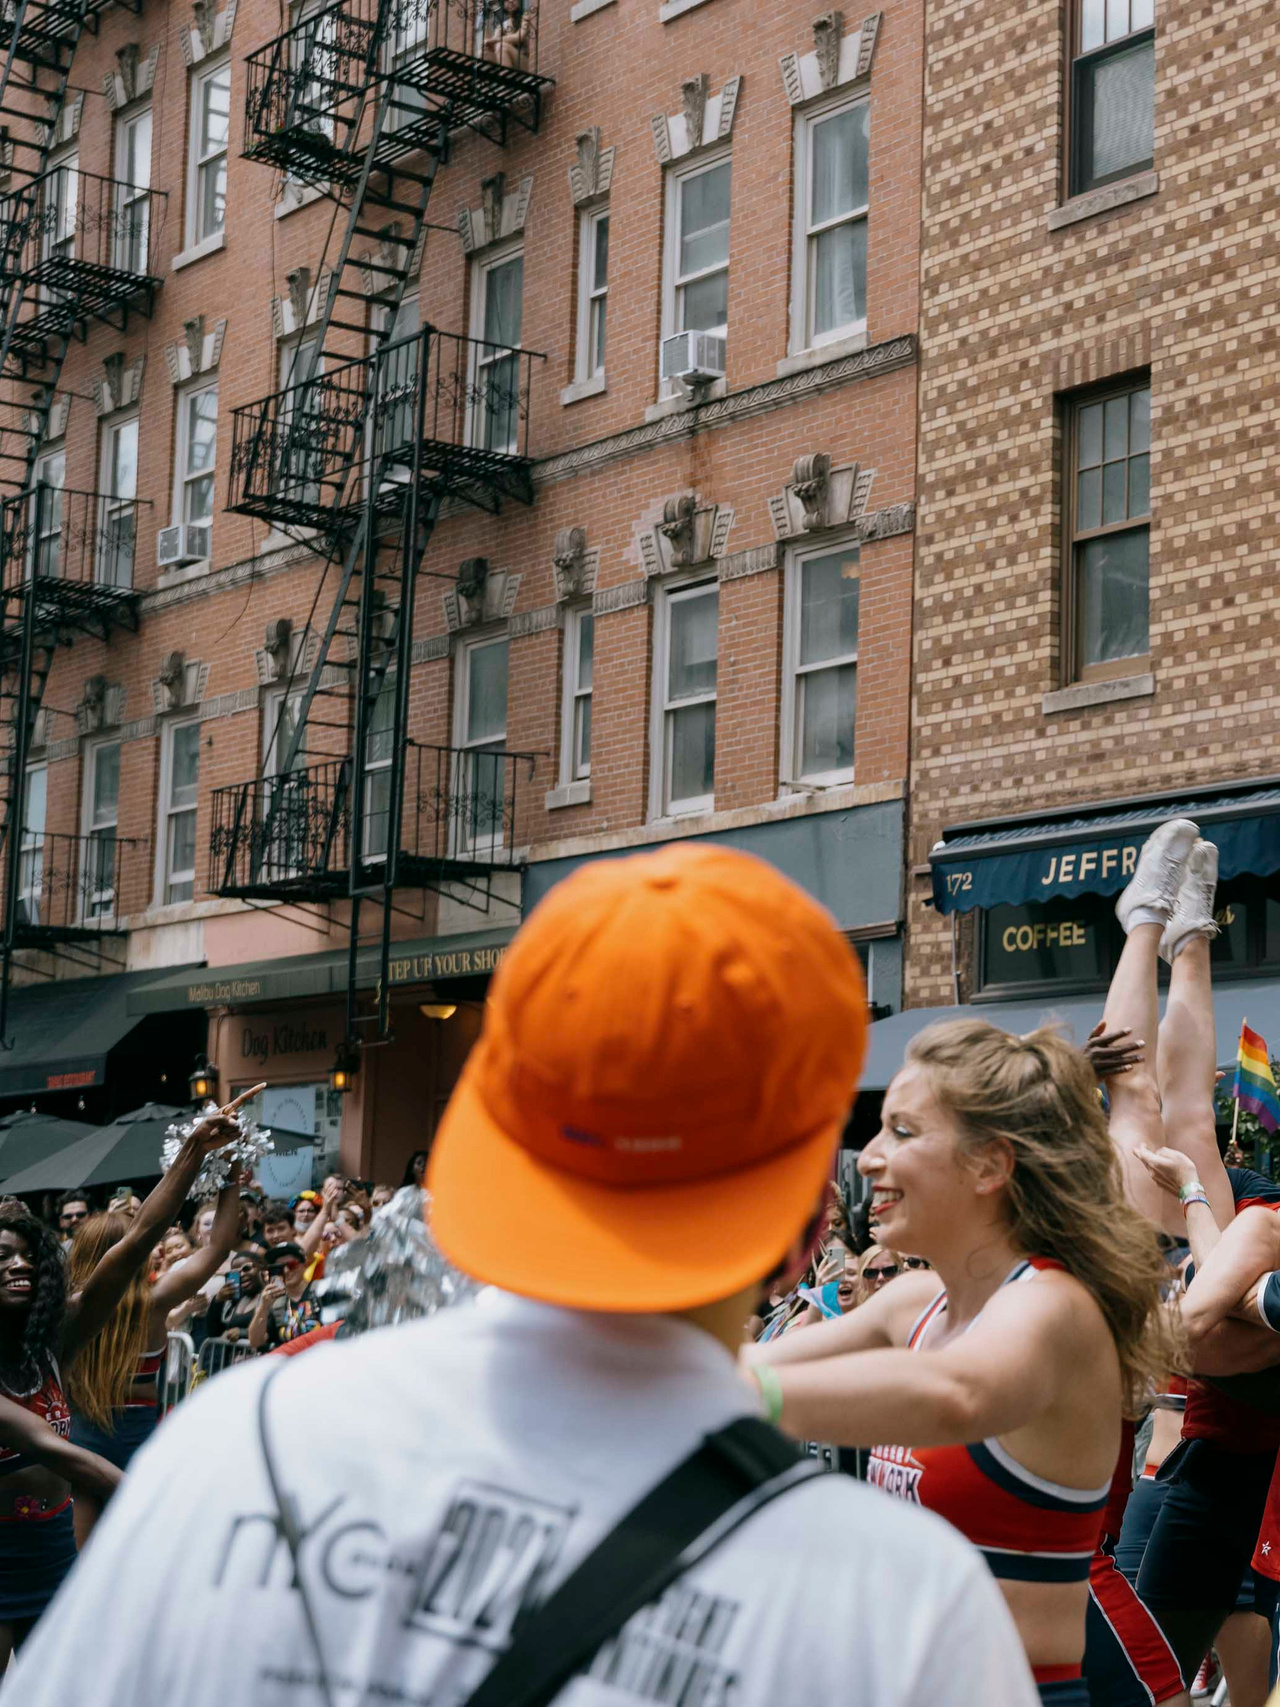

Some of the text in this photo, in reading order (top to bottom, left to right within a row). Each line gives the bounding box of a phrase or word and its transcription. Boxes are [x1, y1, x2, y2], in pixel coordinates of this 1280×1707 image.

[1041, 846, 1147, 886] JEFFR
[945, 872, 973, 896] 172
[1002, 921, 1086, 952] COFFEE
[388, 961, 411, 981] TEP
[435, 952, 471, 976] YOUR
[215, 982, 231, 1002] Dog
[231, 980, 261, 998] Kitchen
[242, 1021, 328, 1066] Dog Kitchen
